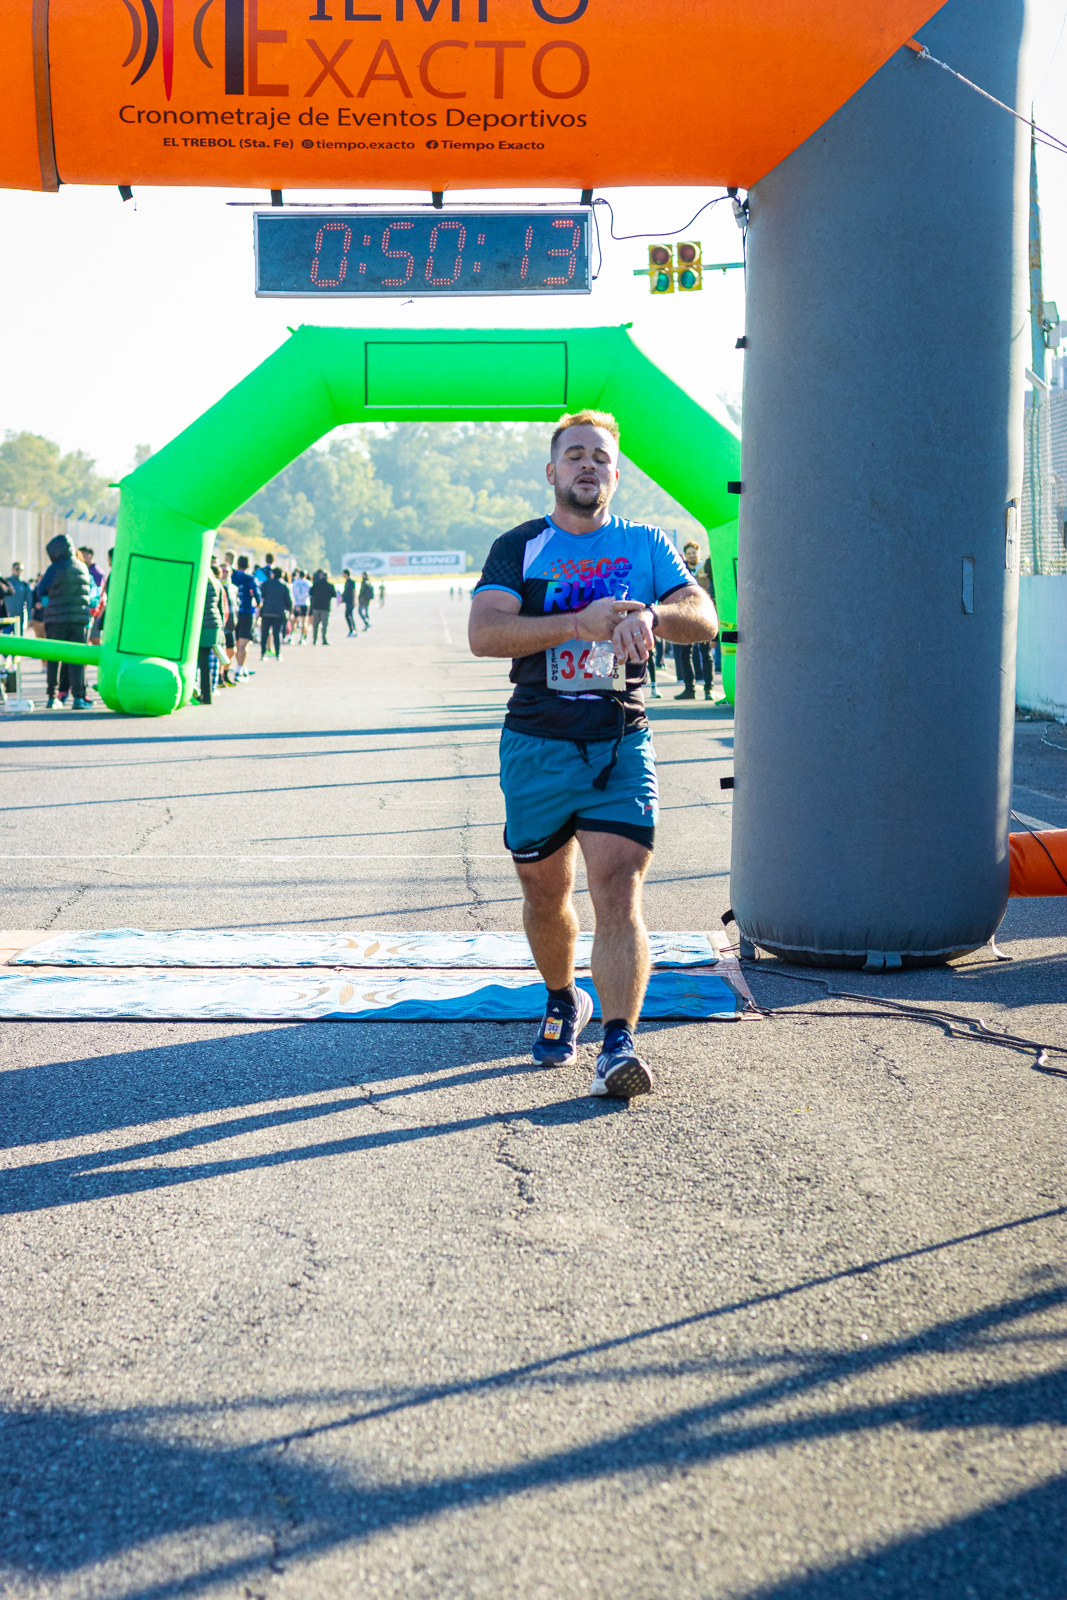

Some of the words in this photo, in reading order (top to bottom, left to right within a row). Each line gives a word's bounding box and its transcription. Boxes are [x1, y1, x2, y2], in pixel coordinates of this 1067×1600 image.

[119, 105, 291, 129] Cronometraje
[298, 107, 329, 126] de
[338, 108, 437, 127] Eventos
[446, 108, 587, 131] Deportivos
[163, 138, 179, 147] EL
[181, 138, 236, 148] TREBOL
[239, 138, 270, 149] (Sta.
[273, 139, 294, 150] Fe)
[316, 140, 415, 151] tiempo.exacto
[441, 140, 495, 151] Tiempo
[499, 141, 545, 150] Exacto
[310, 220, 580, 287] 0:50:13
[578, 557, 630, 581] 500
[606, 563, 633, 571] MILLAS
[551, 647, 559, 681] TIEMPO
[560, 649, 613, 680] 34
